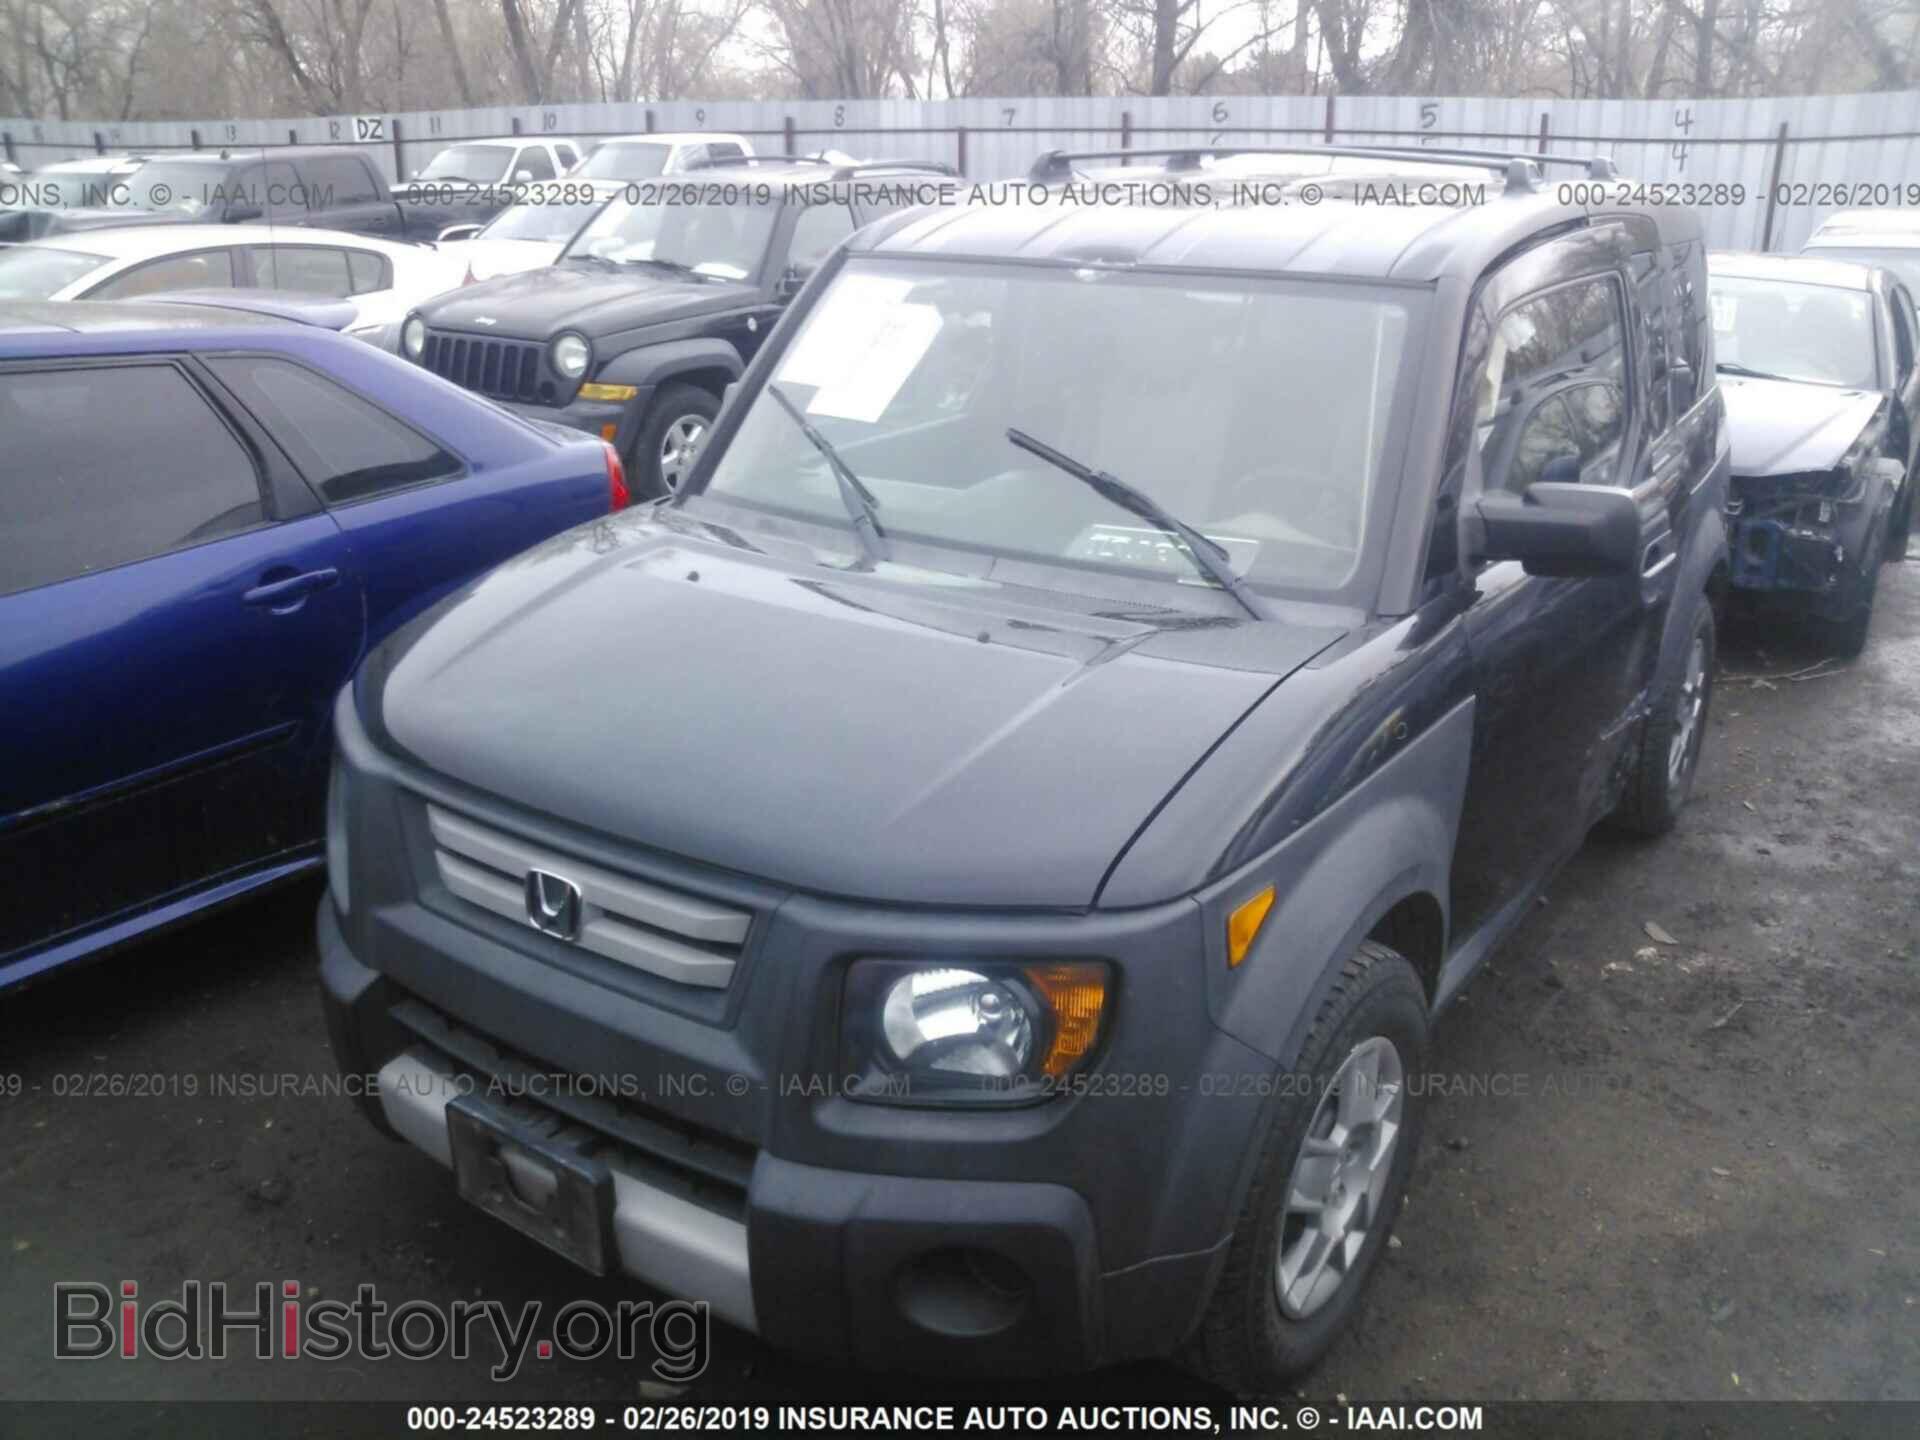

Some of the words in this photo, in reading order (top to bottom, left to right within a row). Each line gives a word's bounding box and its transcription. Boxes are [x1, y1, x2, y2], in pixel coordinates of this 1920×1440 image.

[542, 112, 557, 131] 10
[695, 109, 706, 127] 9
[833, 105, 845, 127] 8
[1002, 108, 1016, 126] 7
[1211, 102, 1229, 123] 6
[1419, 103, 1438, 129] 5
[1674, 108, 1694, 135] 4
[356, 118, 384, 139] DZ
[429, 115, 442, 134] 11
